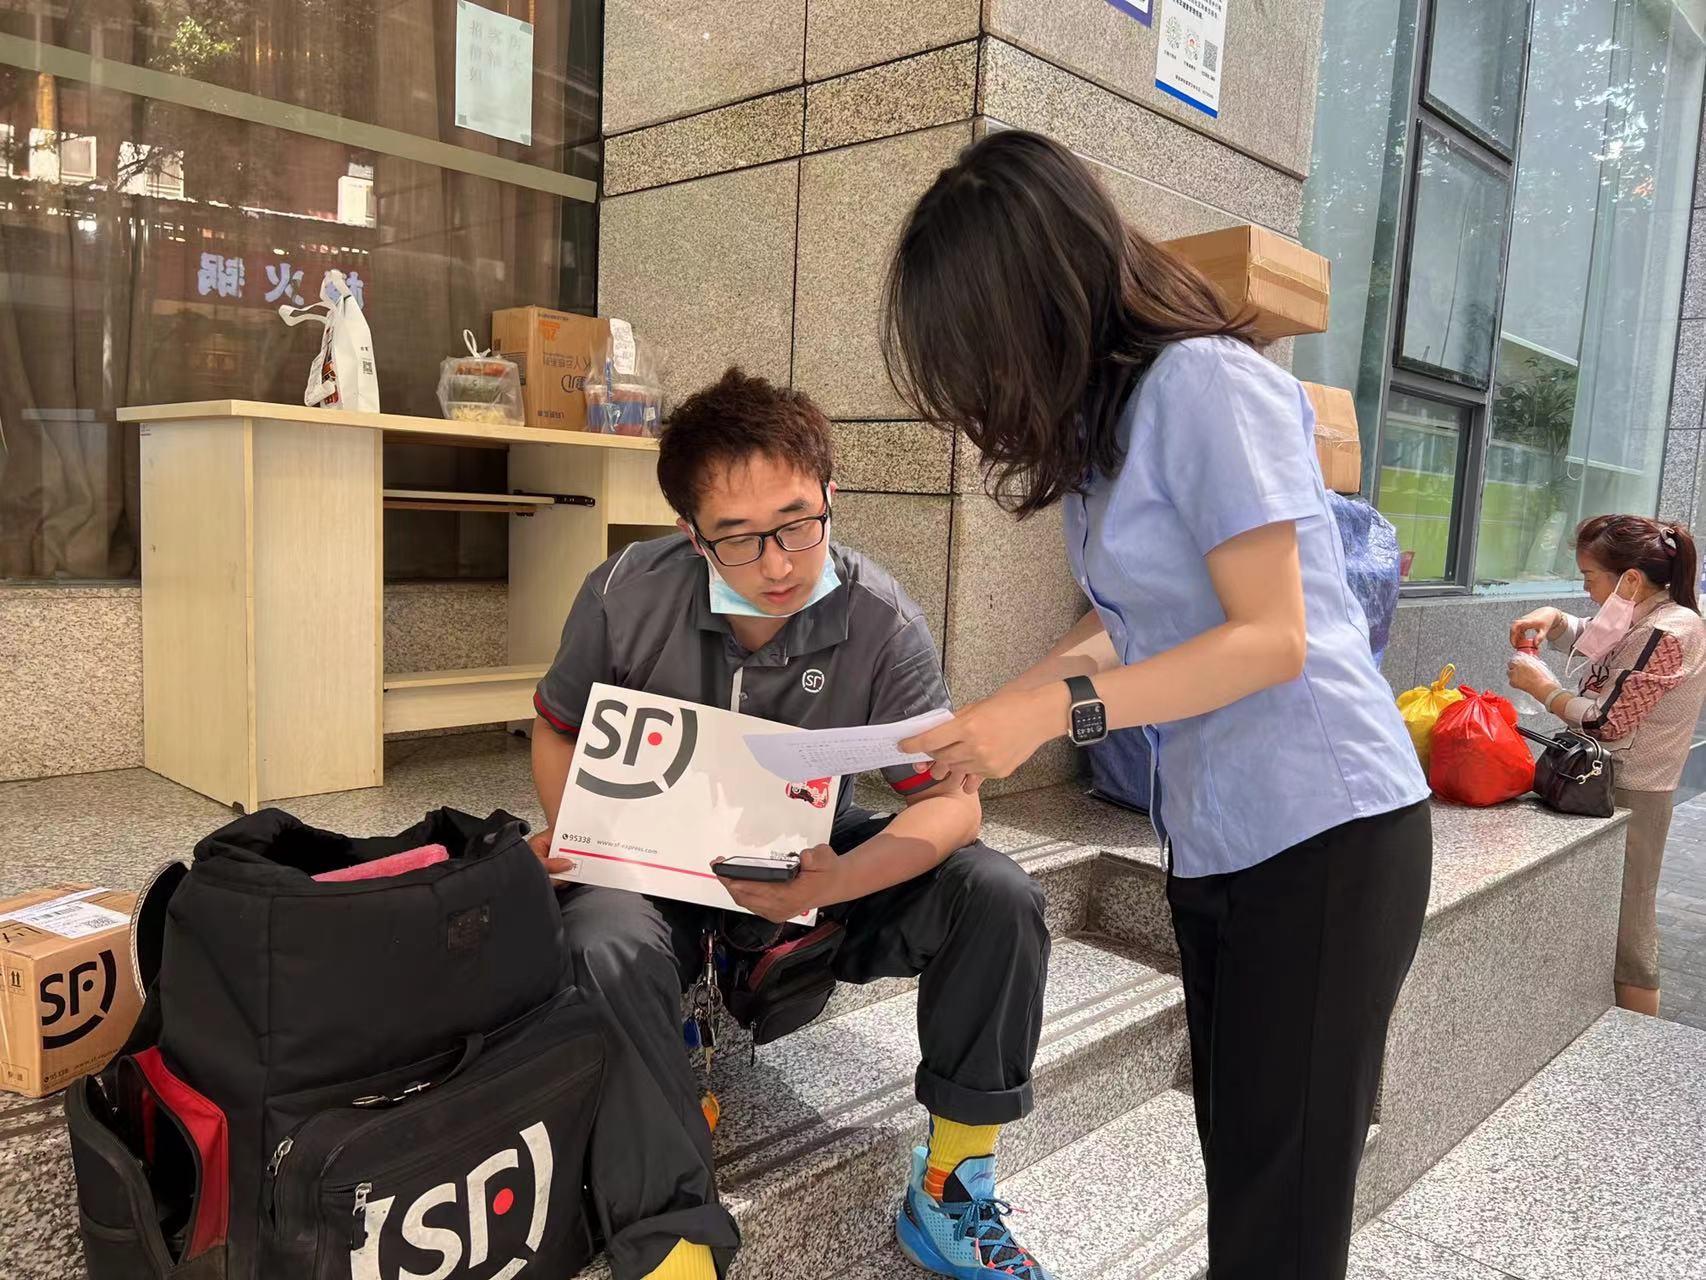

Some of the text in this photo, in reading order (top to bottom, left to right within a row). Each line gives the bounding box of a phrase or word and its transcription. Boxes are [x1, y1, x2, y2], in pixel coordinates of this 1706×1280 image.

[583, 699, 675, 767] SF
[569, 834, 592, 844] 95338
[40, 961, 98, 1027] SF
[399, 1148, 519, 1280] SF
